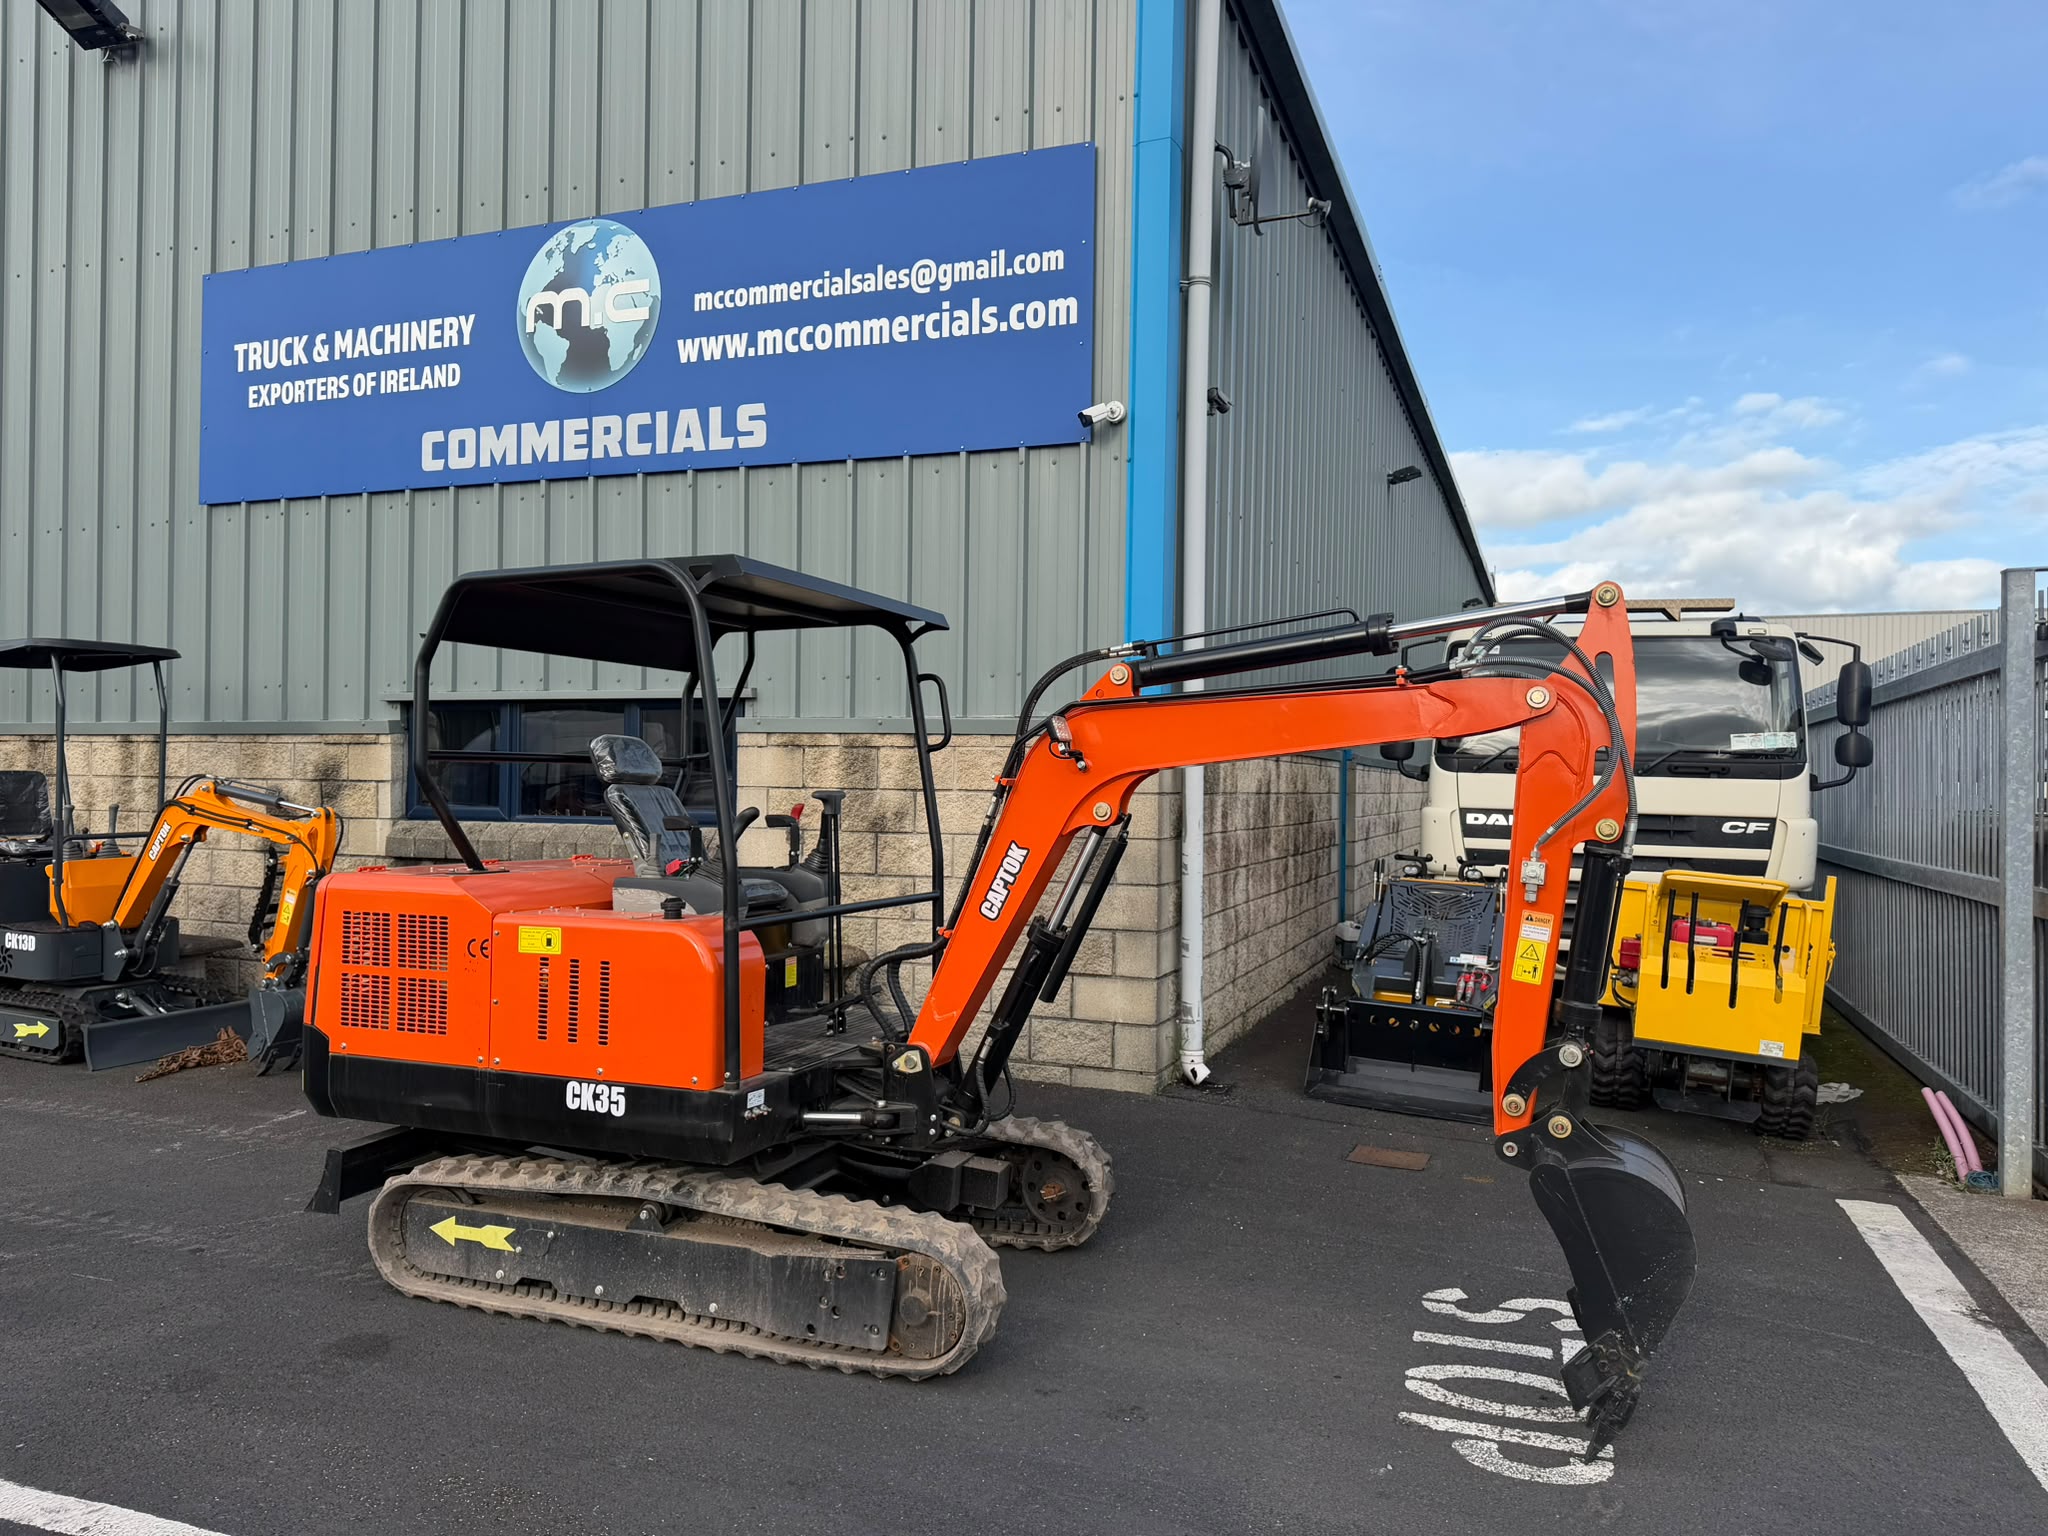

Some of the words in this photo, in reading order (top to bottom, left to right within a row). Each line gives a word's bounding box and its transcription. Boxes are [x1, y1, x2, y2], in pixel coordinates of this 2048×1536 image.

[694, 249, 1065, 312] mccommercialsales@gmail.com
[234, 335, 308, 373] TRUCK
[312, 332, 330, 363] &
[334, 314, 476, 361] MACHINERY
[677, 296, 1078, 364] www.mccommercials.com
[248, 375, 350, 409] EXPORTERS
[352, 371, 377, 397] OF
[380, 363, 461, 394] IRELAND
[421, 402, 768, 472] COMMERCIALS
[148, 820, 171, 861] CAPTOK
[1466, 813, 1513, 826] DA
[1721, 821, 1771, 834] CF
[980, 841, 1029, 920] CAPTOK
[5, 932, 36, 952] CK13D
[565, 1080, 626, 1118] CK35
